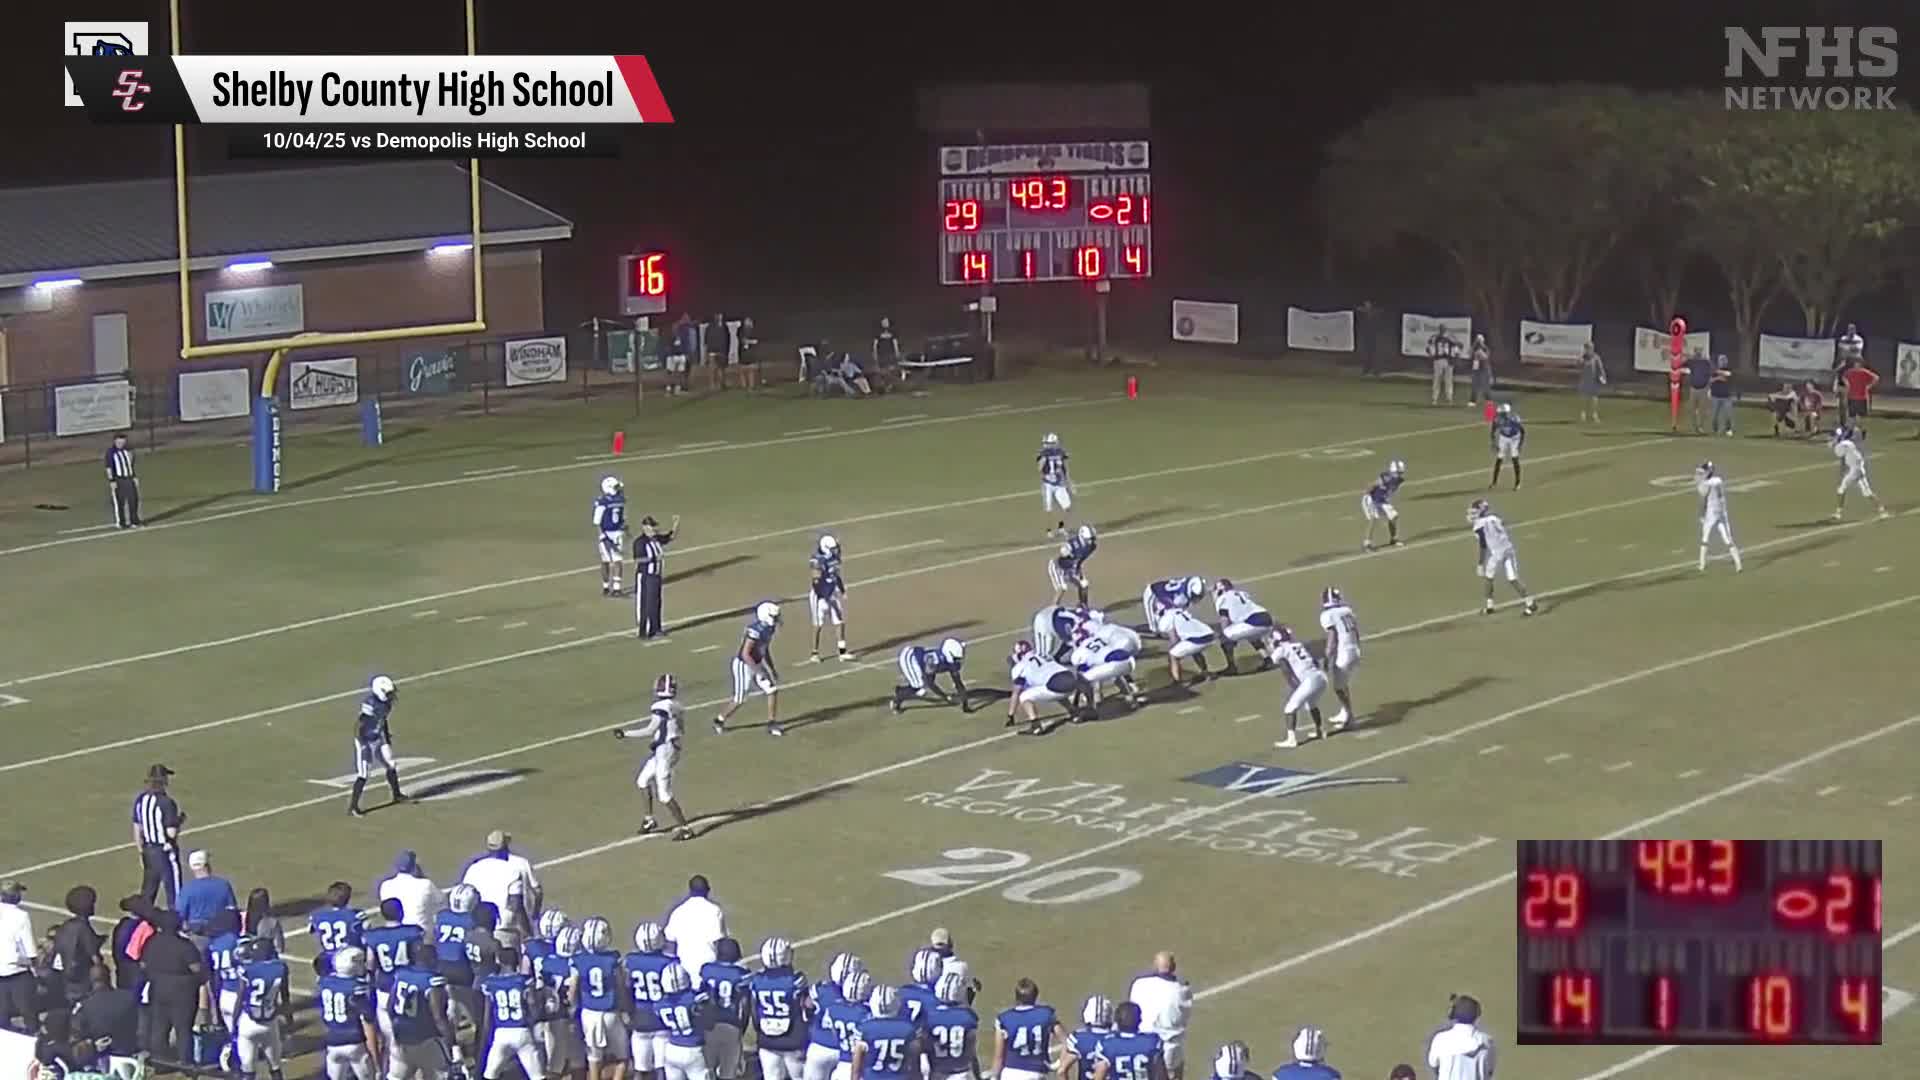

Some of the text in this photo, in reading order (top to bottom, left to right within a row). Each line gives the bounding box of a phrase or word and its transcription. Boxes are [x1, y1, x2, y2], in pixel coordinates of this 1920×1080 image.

[1011, 181, 1067, 209] 49.3
[1116, 197, 1148, 224] 21
[945, 201, 978, 230] 29
[639, 254, 665, 295] 16
[963, 254, 986, 279] 14
[1077, 248, 1100, 277] 10
[1126, 247, 1140, 273] 4
[952, 768, 1499, 864] Whitfield
[1168, 829, 1418, 878] HOSPITAL
[882, 847, 1144, 905] 20
[318, 921, 348, 950] 22
[376, 941, 410, 972] 64
[589, 966, 604, 998] 9
[631, 970, 662, 1002] 26
[758, 990, 790, 1017] 55
[872, 1038, 905, 1072] 75
[1013, 1025, 1043, 1057] 41
